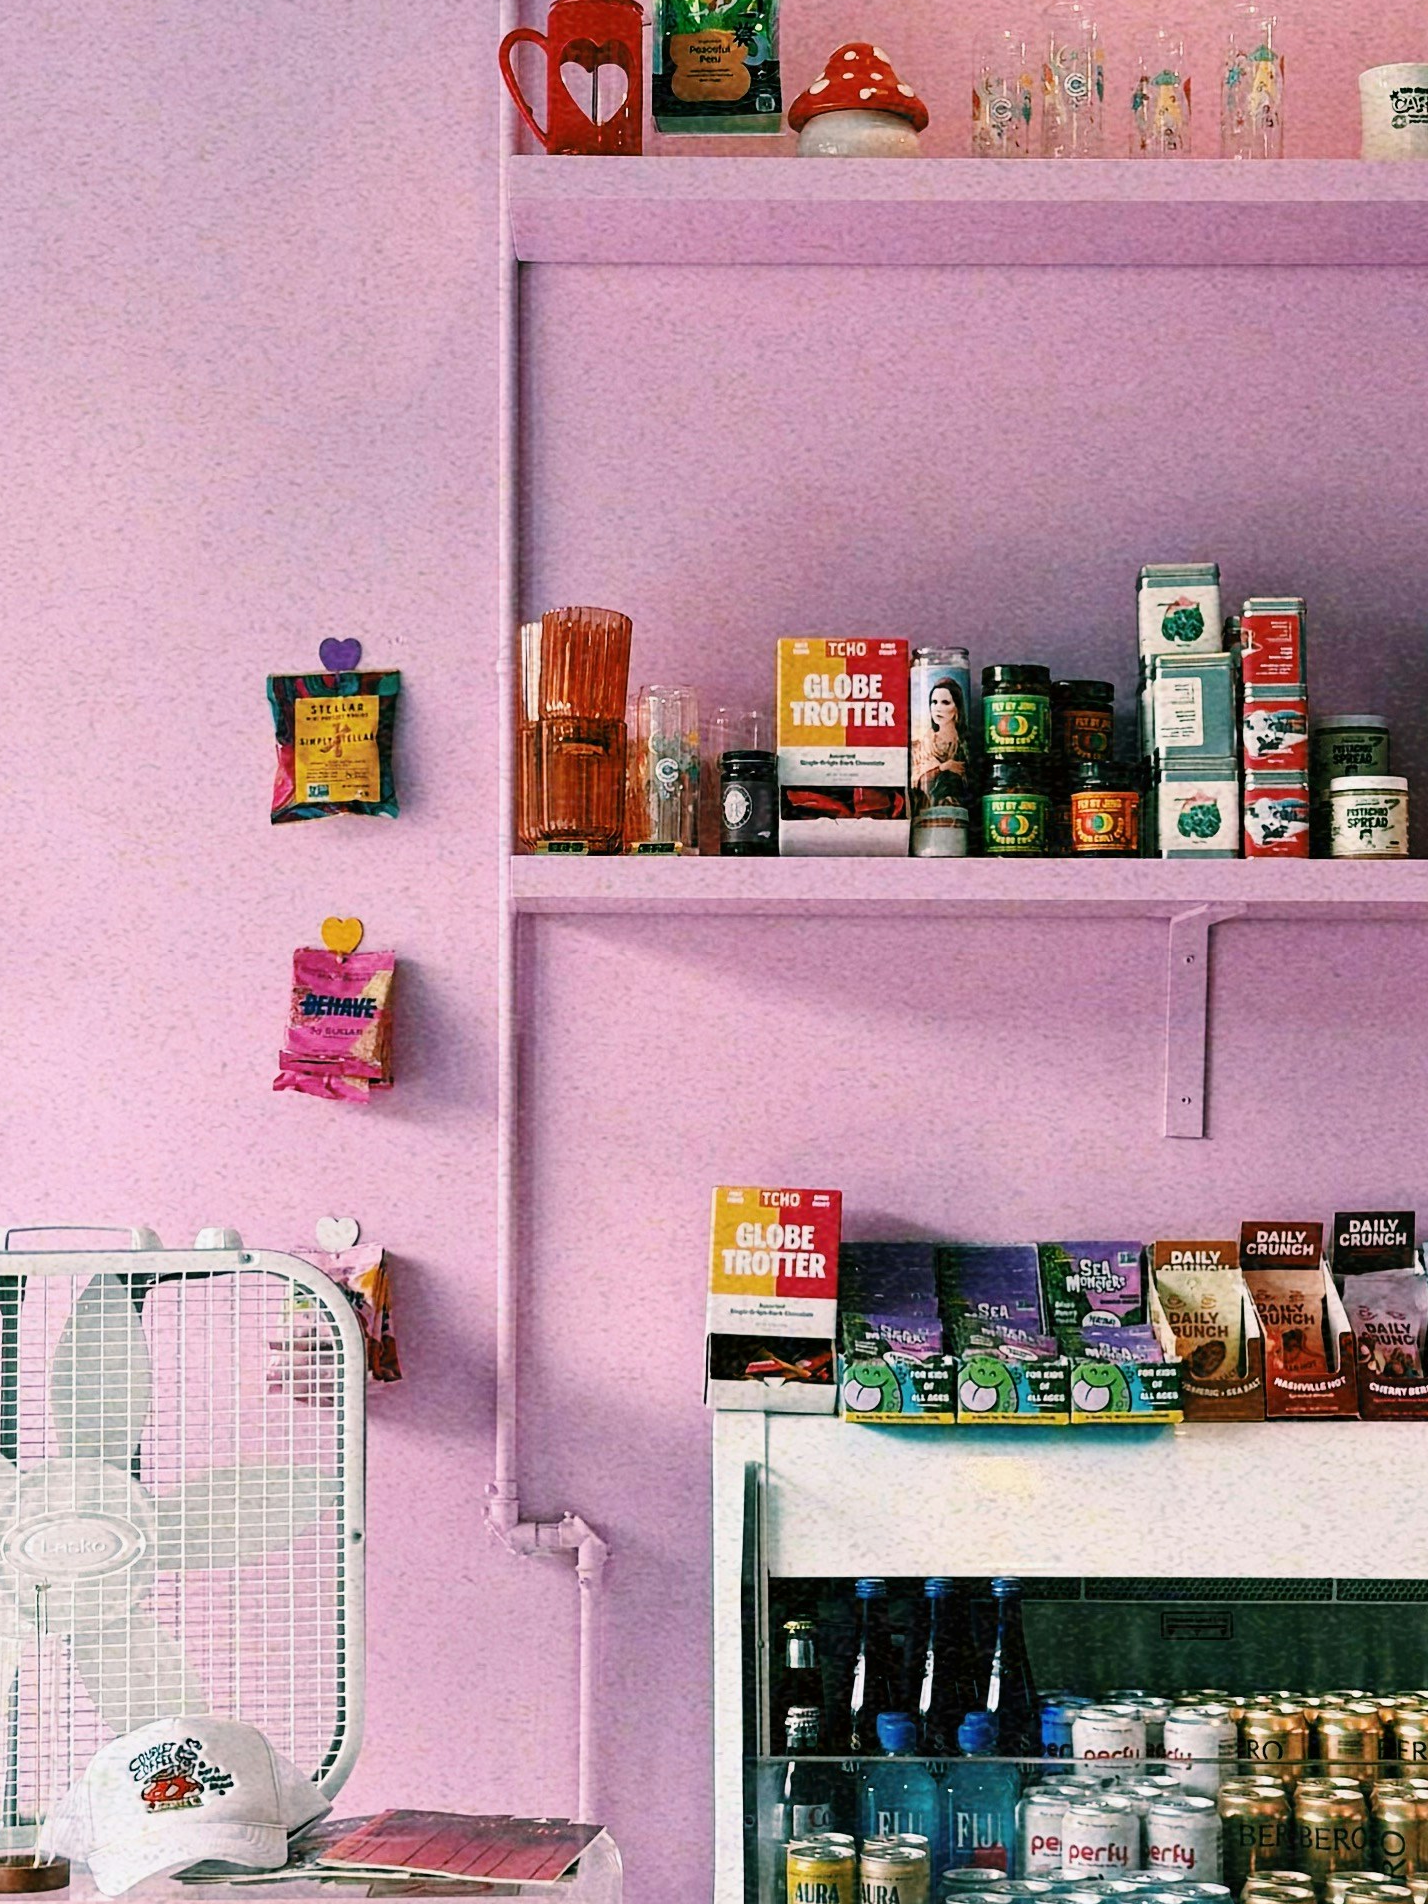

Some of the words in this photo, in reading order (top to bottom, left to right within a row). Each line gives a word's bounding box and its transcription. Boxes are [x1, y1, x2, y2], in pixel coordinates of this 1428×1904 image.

[828, 642, 866, 657] TCHO
[803, 673, 883, 699] GLOBE
[310, 703, 364, 715] STELLAR
[789, 701, 896, 727] TROTTER
[299, 738, 332, 746] SIMPLY
[1332, 754, 1373, 765] SPREAD
[1347, 817, 1388, 829] SPREAD
[300, 993, 378, 1019] BEHAVE
[762, 1191, 801, 1207] TCHO
[1349, 1219, 1399, 1233] DAILY
[735, 1222, 815, 1250] GLOBE
[1256, 1230, 1307, 1244] DAILY
[1339, 1233, 1407, 1247] CRUNCH
[1246, 1243, 1315, 1256] CRUNCH
[721, 1249, 826, 1279] TROTTER
[1171, 1250, 1222, 1265] DAILY
[1079, 1259, 1113, 1277] SEA
[1065, 1274, 1127, 1294] MONSTERS
[977, 1303, 1010, 1319] SEA
[1257, 1303, 1304, 1313] DAILY
[1169, 1312, 1220, 1325] DAILY
[1260, 1312, 1315, 1325] RUNCH
[1172, 1325, 1229, 1338] RUNCH
[1365, 1322, 1411, 1334] DAILY
[910, 1371, 926, 1379] FOR
[927, 1371, 949, 1379] KIDS
[1025, 1371, 1042, 1379] FOR
[1043, 1371, 1065, 1379] KIDS
[1138, 1369, 1153, 1377] FOR
[1155, 1368, 1177, 1377] KIDS
[1274, 1377, 1326, 1392] NASHVILLE
[1327, 1376, 1346, 1390] HOT
[1369, 1382, 1408, 1396] CHERRY
[927, 1394, 950, 1402] AGES
[1043, 1394, 1065, 1402] AGES
[1140, 1392, 1155, 1400] ALL
[1156, 1391, 1179, 1400] AGES
[957, 1812, 1003, 1848] FIJI
[1068, 1843, 1129, 1867] perfy
[1149, 1844, 1196, 1869] erfy
[795, 1882, 841, 1904] AURA
